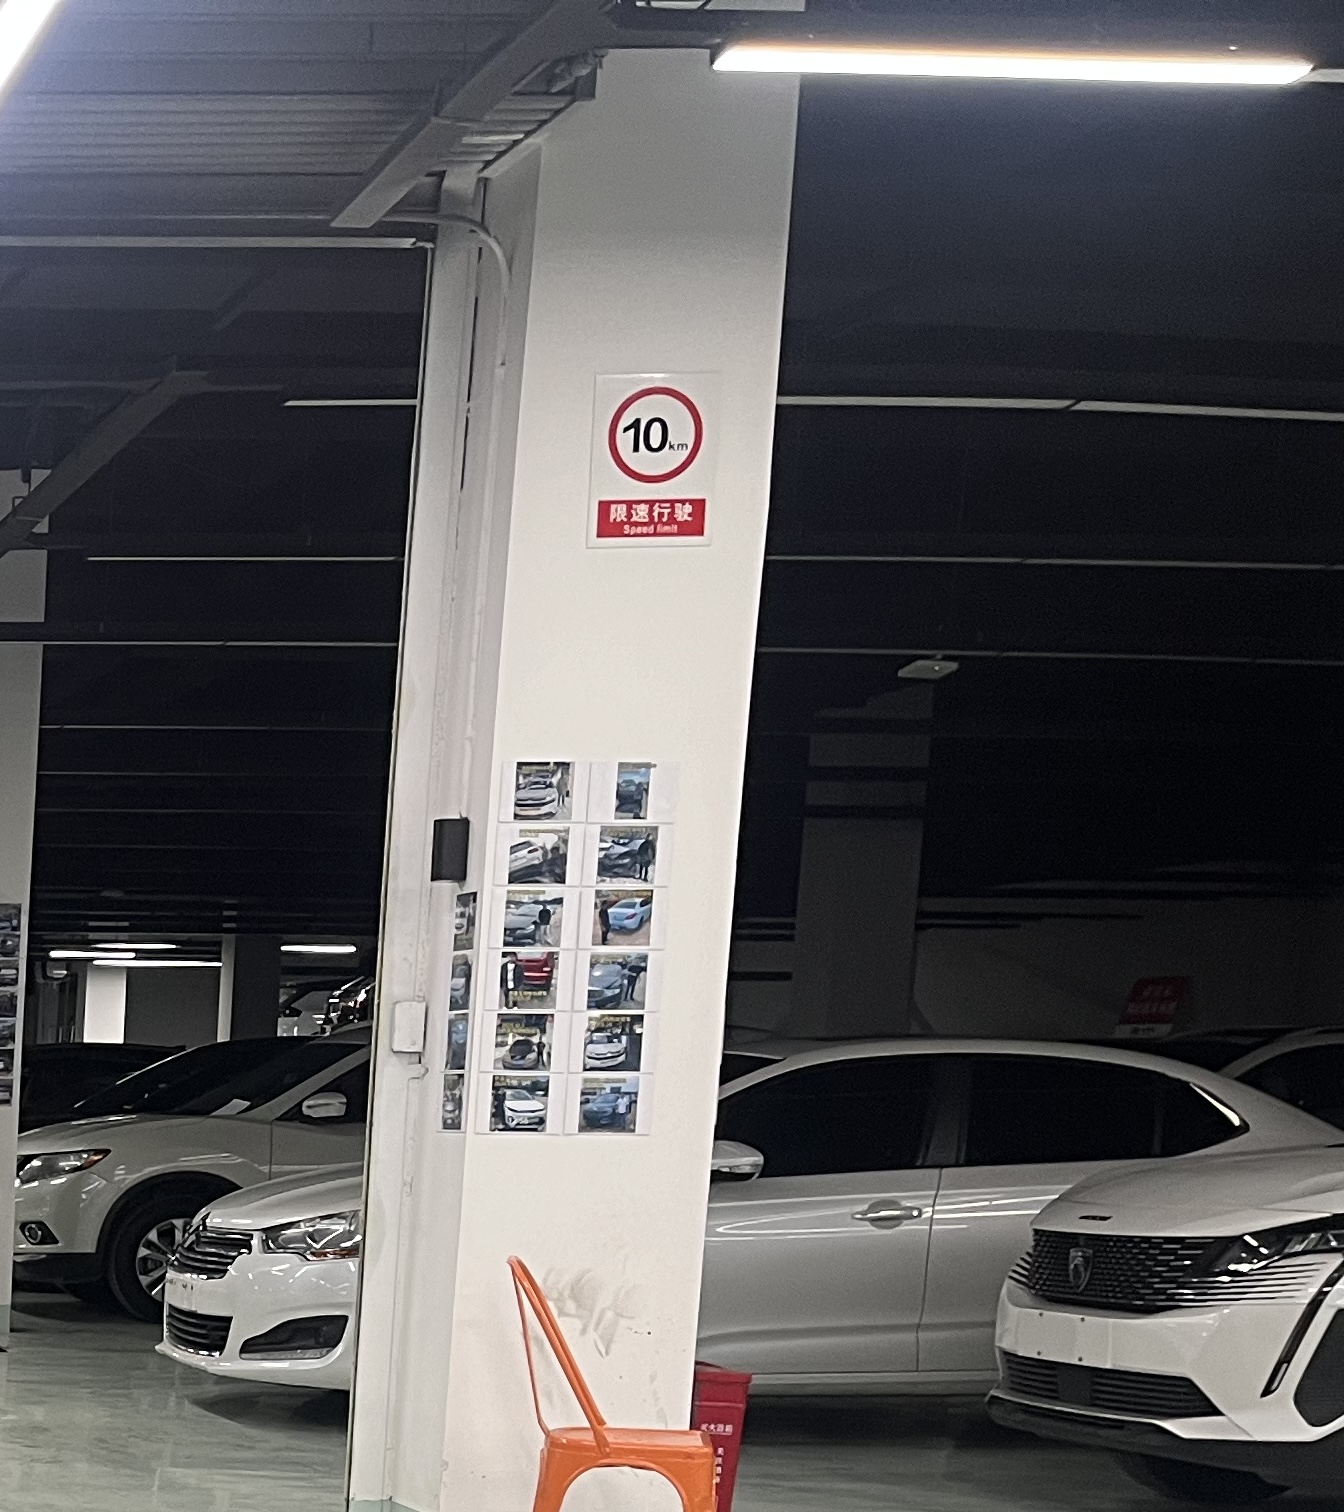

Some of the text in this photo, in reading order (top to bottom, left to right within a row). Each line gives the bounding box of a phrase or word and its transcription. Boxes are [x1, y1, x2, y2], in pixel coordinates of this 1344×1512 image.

[610, 502, 693, 523] 限速行驶
[623, 523, 678, 535] Speed limit
